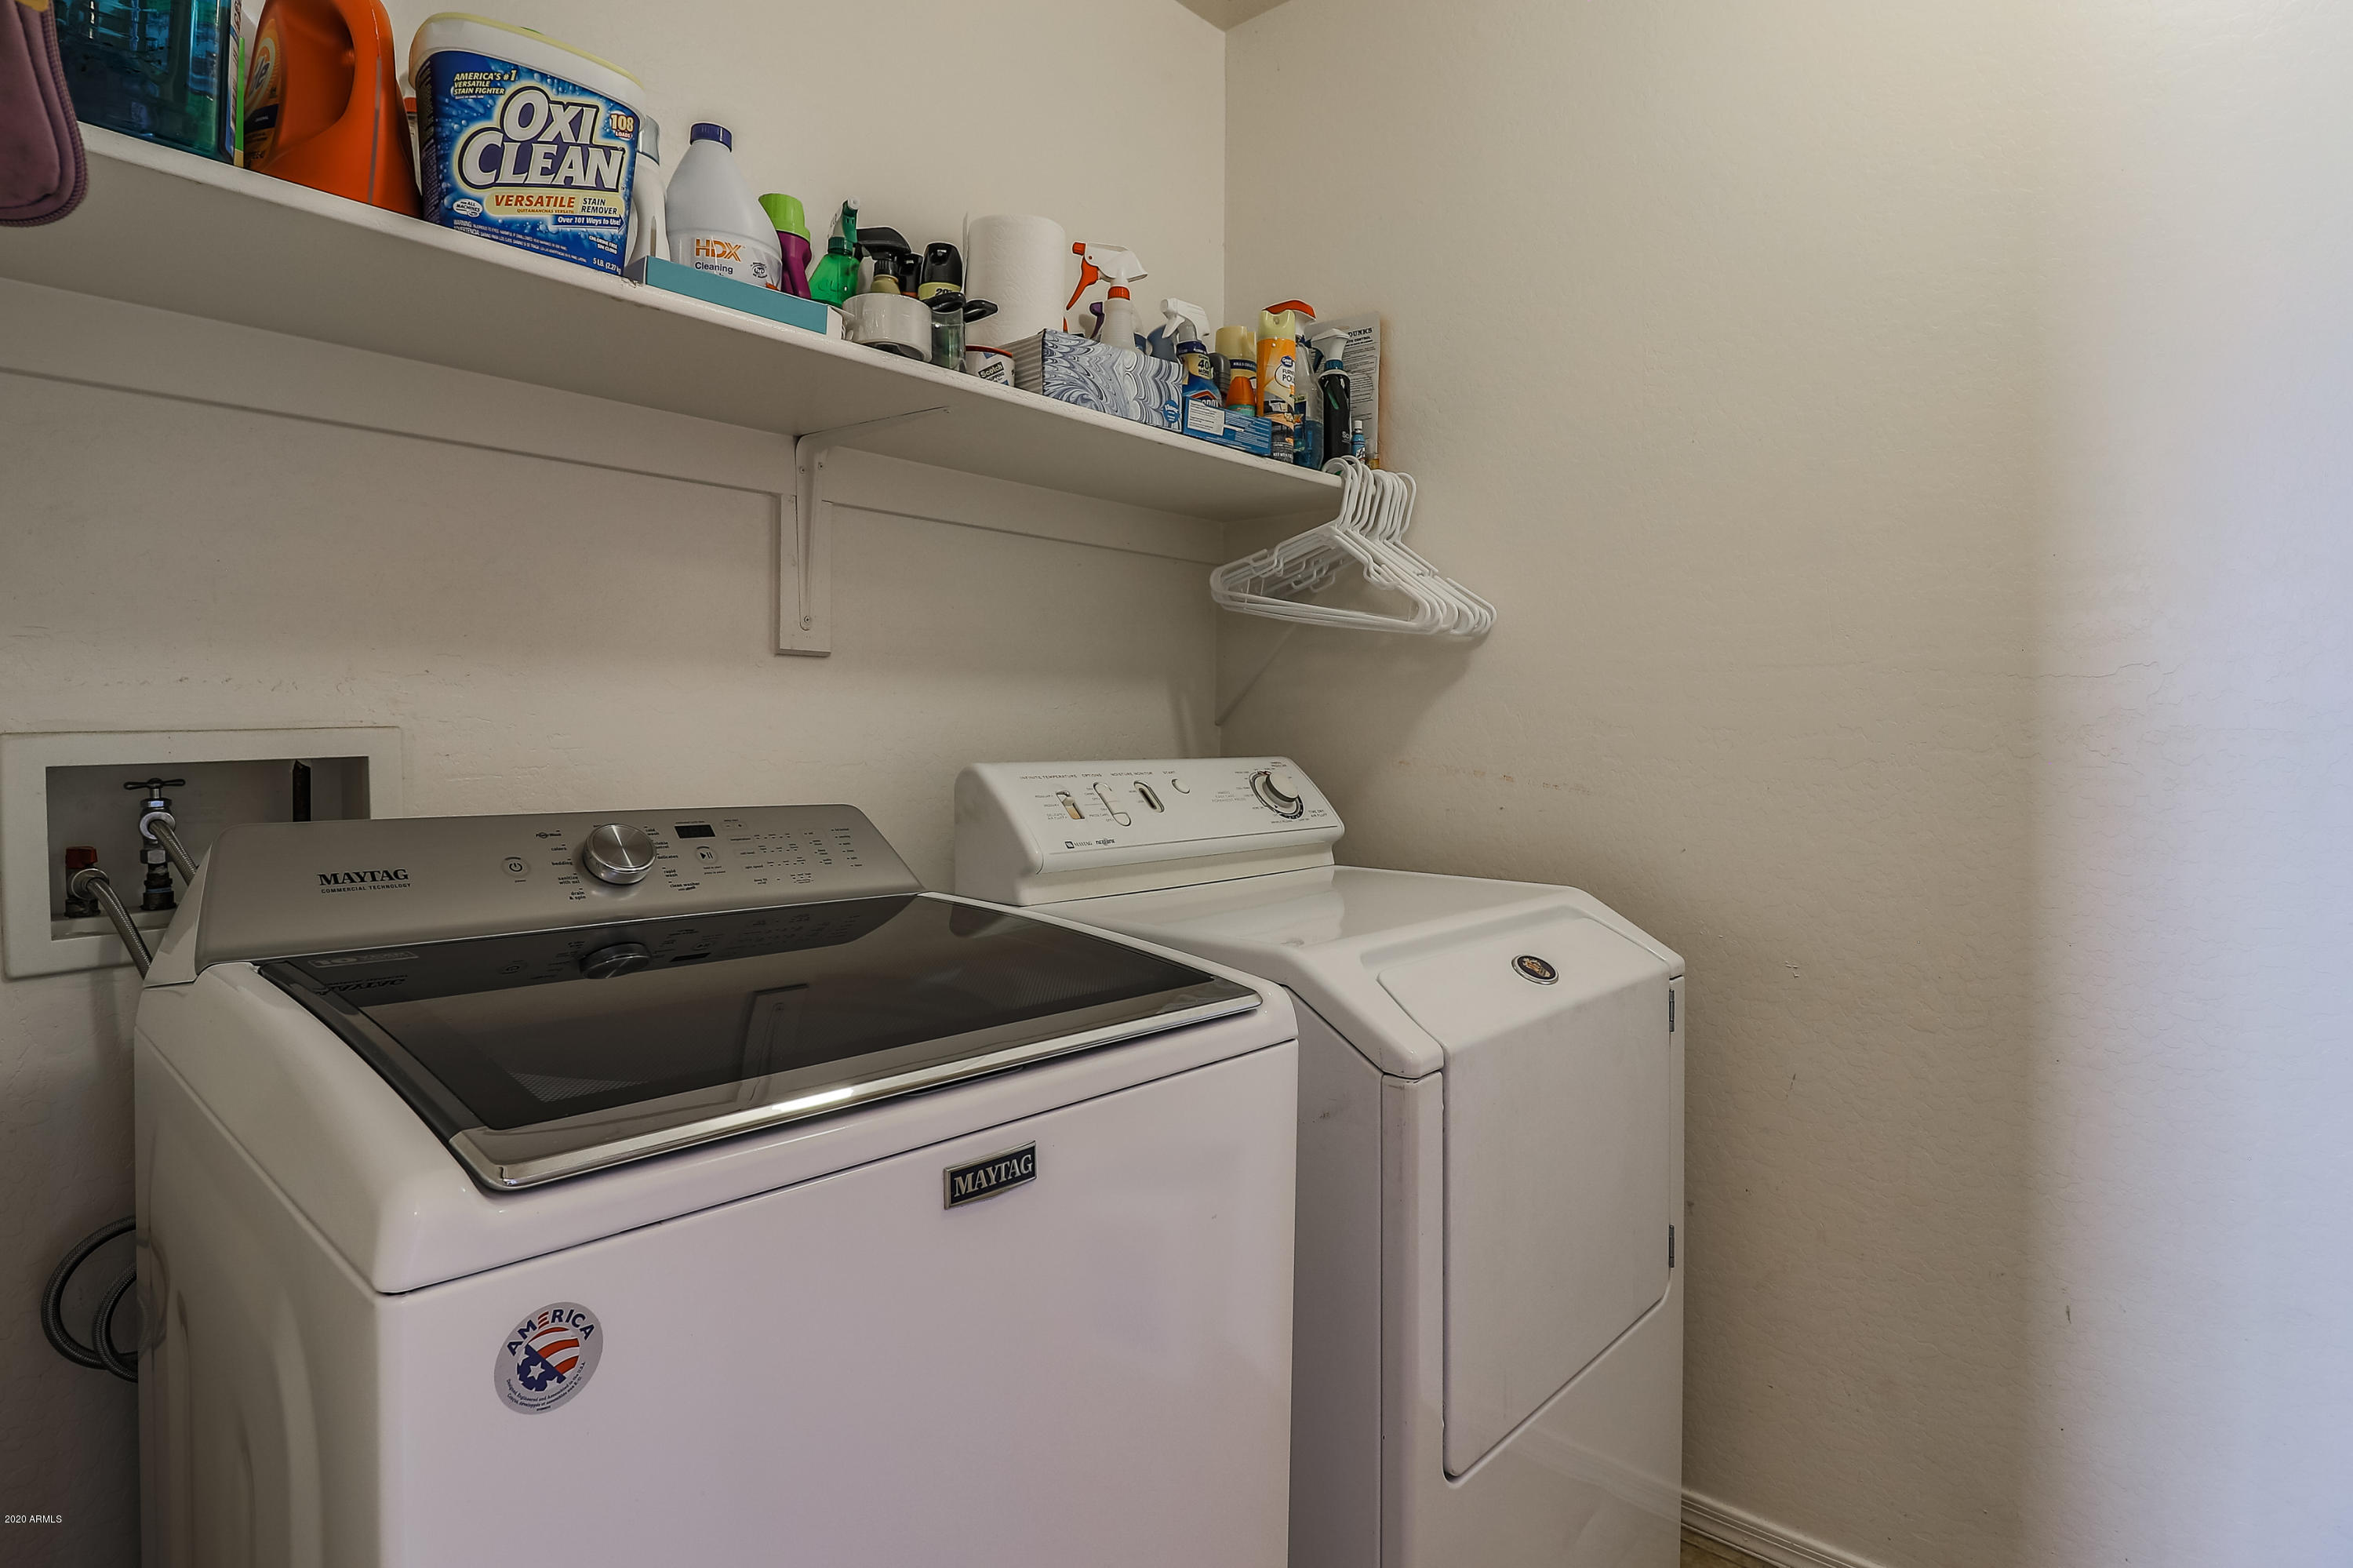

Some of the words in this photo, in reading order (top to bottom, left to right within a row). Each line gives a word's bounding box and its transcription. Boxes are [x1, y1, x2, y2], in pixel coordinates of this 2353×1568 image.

[454, 72, 502, 81] AMERICA'S
[502, 87, 594, 144] OXI
[610, 114, 635, 132] 108
[461, 129, 625, 189] CLEAN
[456, 204, 481, 213] MACHINES
[495, 195, 576, 208] VERSATILE
[581, 206, 617, 215] REMOVER
[586, 217, 602, 226] Ways
[695, 238, 742, 262] HDX
[695, 261, 733, 275] Cleaning
[1348, 327, 1373, 337] DUNKS
[980, 363, 1004, 379] Scotch
[317, 868, 409, 886] MAYTAG
[369, 882, 412, 891] TECHNOLOGY
[954, 1154, 1033, 1198] MAYTAG
[507, 1309, 595, 1356] AMERICA
